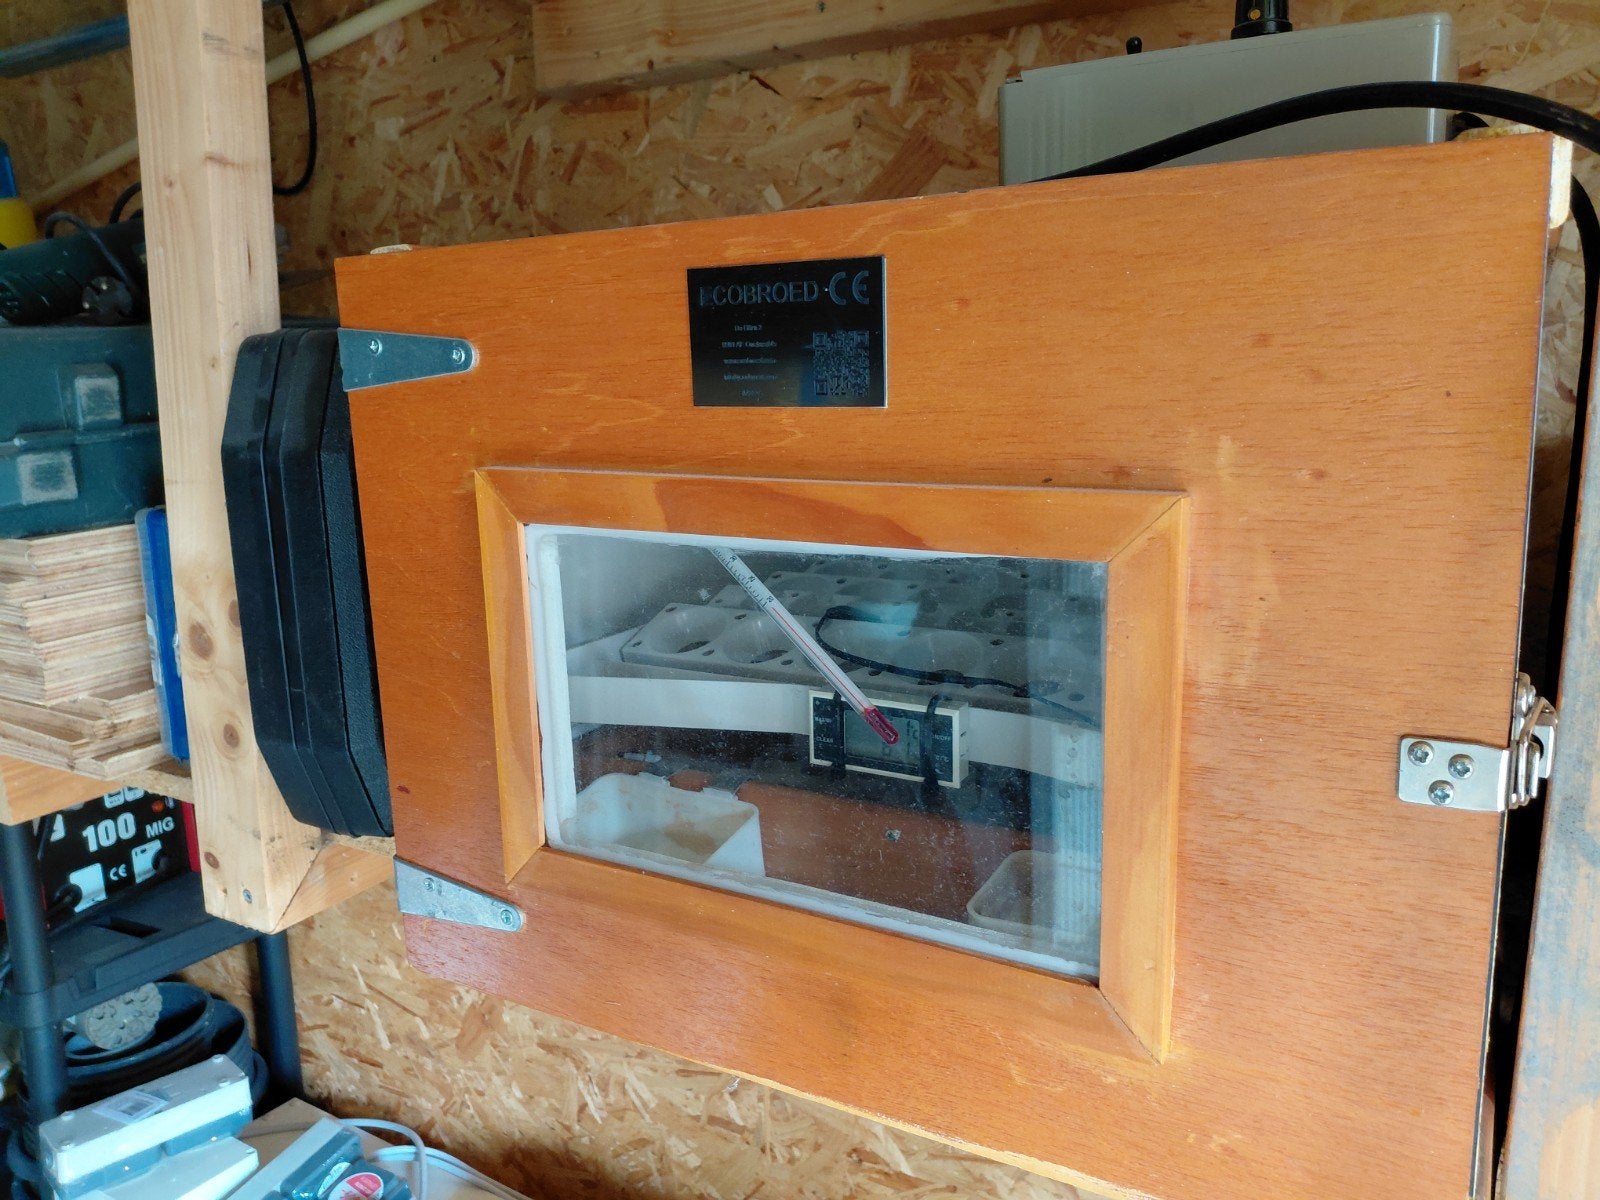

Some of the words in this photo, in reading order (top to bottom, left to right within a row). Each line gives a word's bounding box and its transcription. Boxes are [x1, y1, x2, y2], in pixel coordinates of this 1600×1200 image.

[699, 280, 819, 307] ECOBROED
[82, 811, 136, 853] 100
[145, 816, 175, 839] MIG
[109, 863, 128, 882] CE
